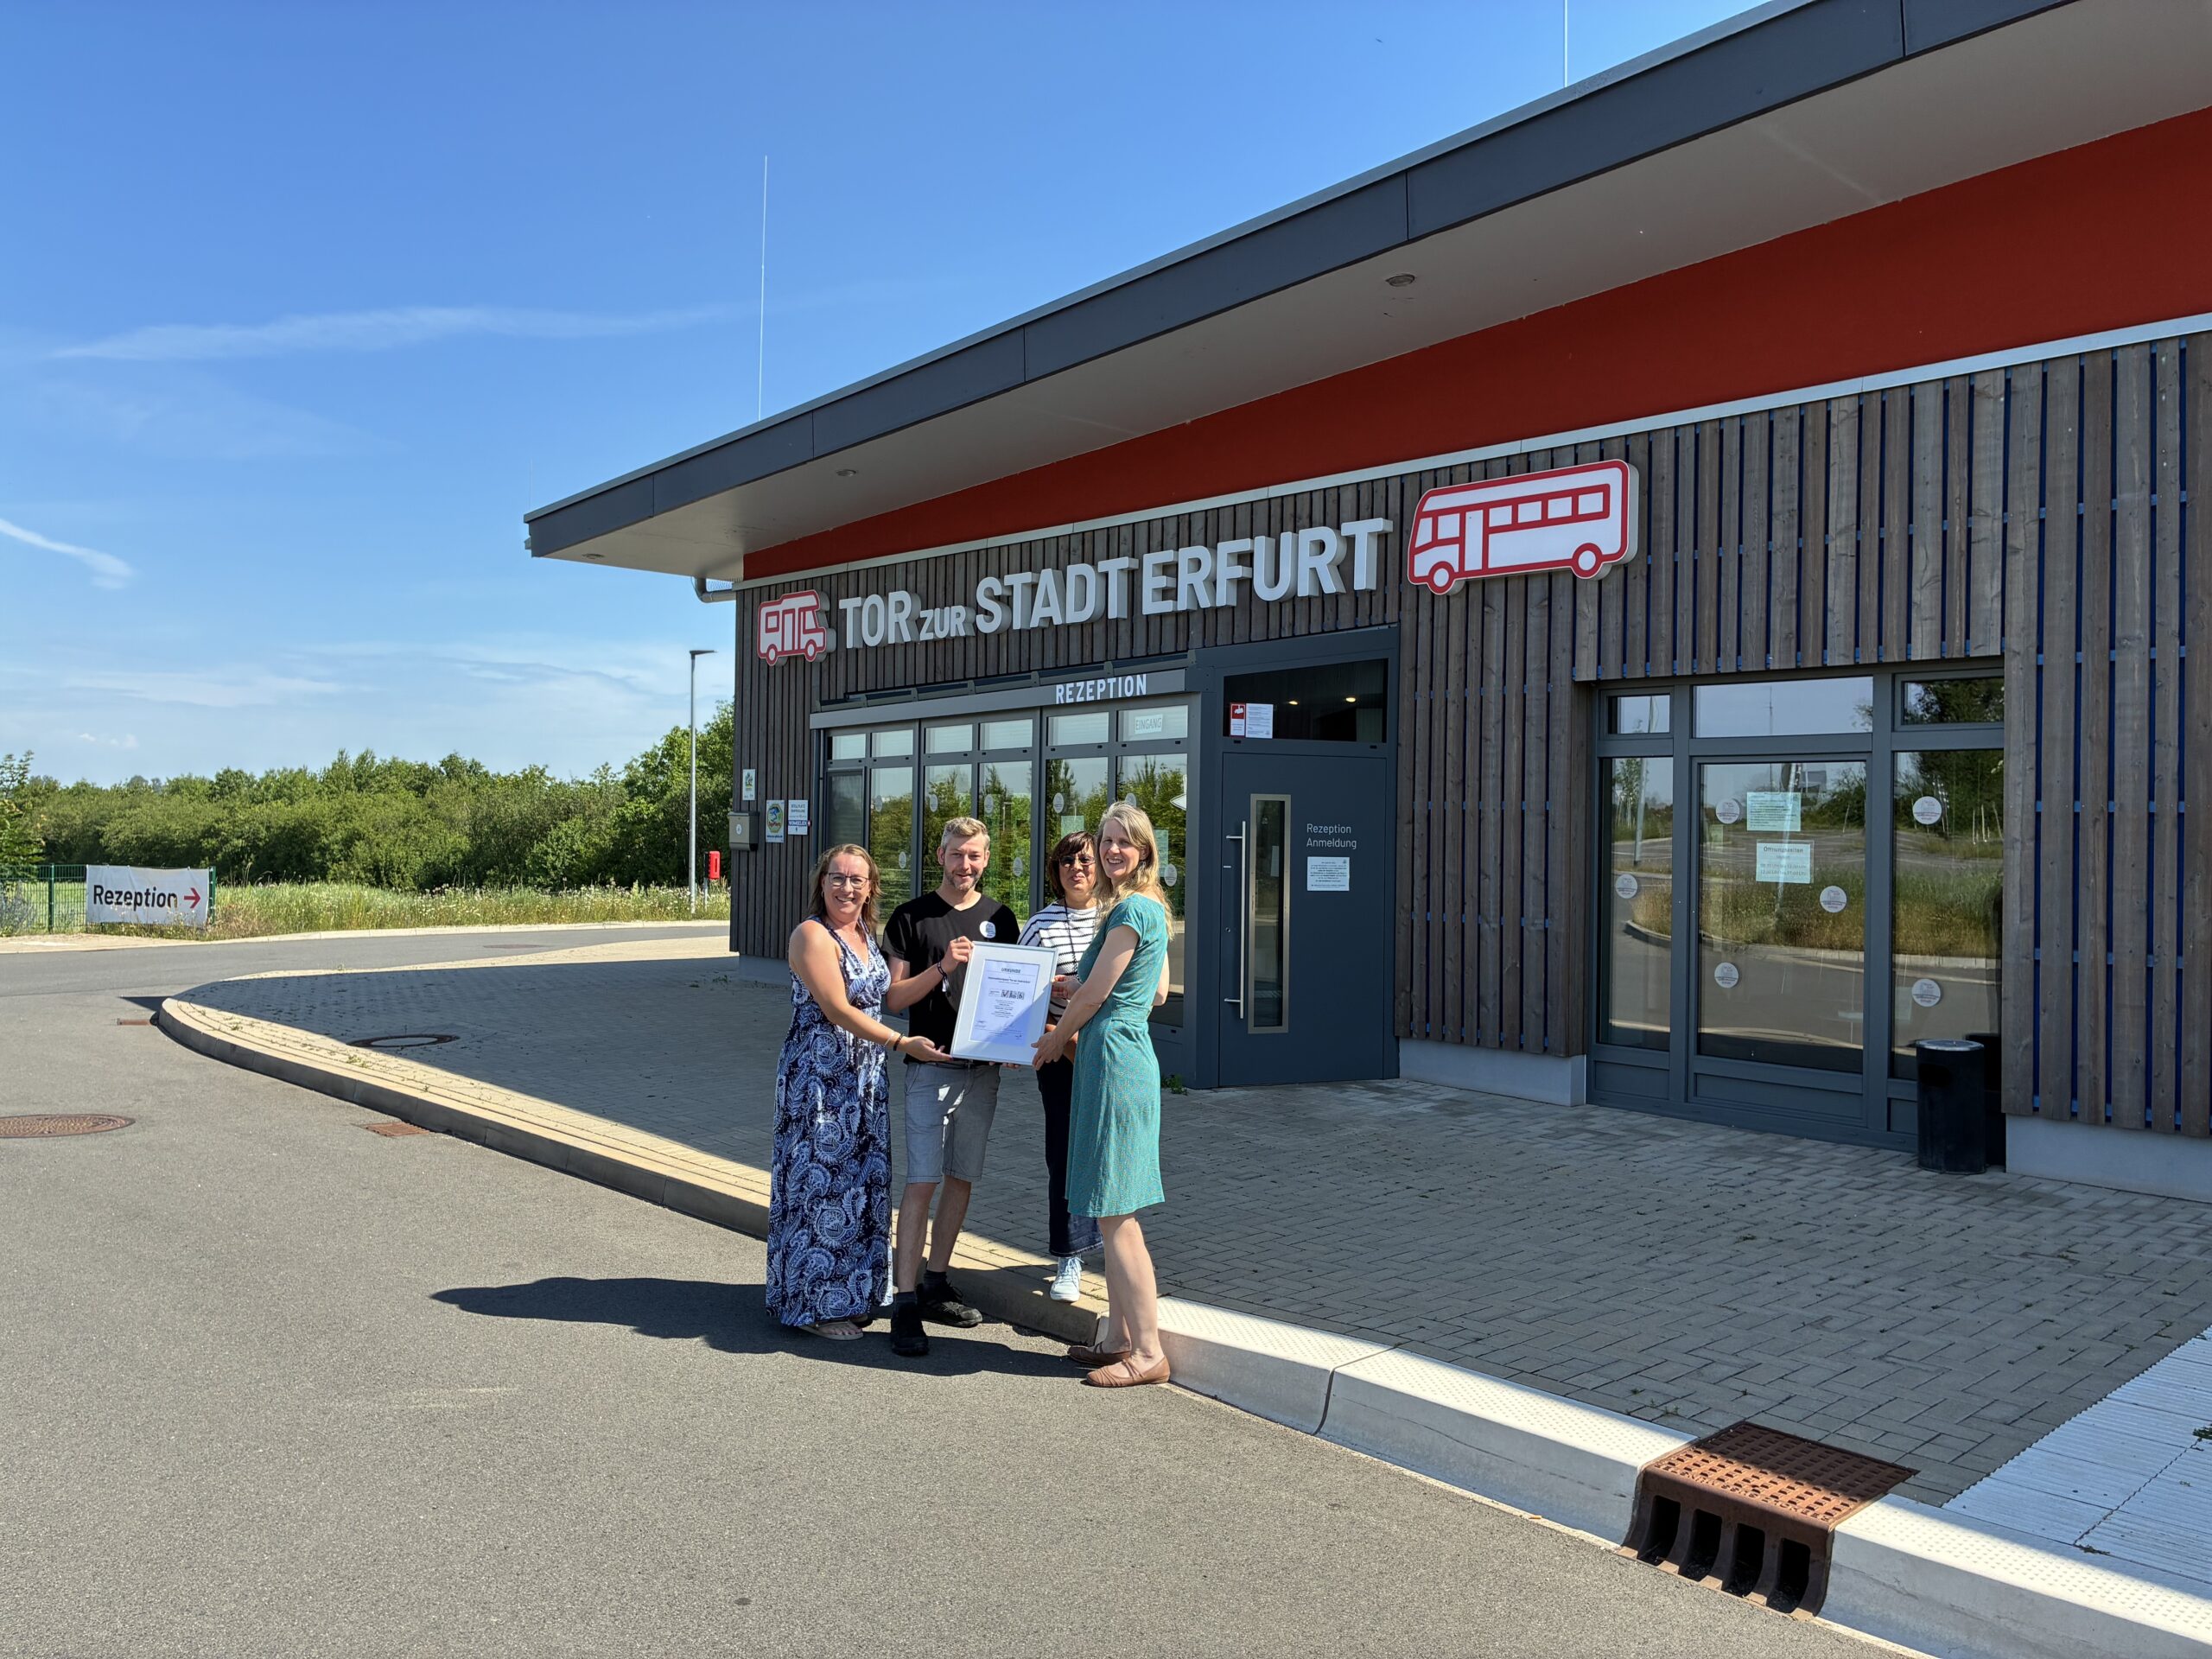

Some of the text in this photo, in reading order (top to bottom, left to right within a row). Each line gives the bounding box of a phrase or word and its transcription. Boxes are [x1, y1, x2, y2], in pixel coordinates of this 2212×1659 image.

[838, 518, 1391, 649] TOR ZUR STADT ERFURT
[1055, 673, 1147, 704] REZEPTION
[1135, 716, 1162, 731] EINGANG
[1306, 823, 1351, 835] Rezeption
[1306, 837, 1357, 849] Anmeldung
[93, 885, 178, 912] Rezeption
